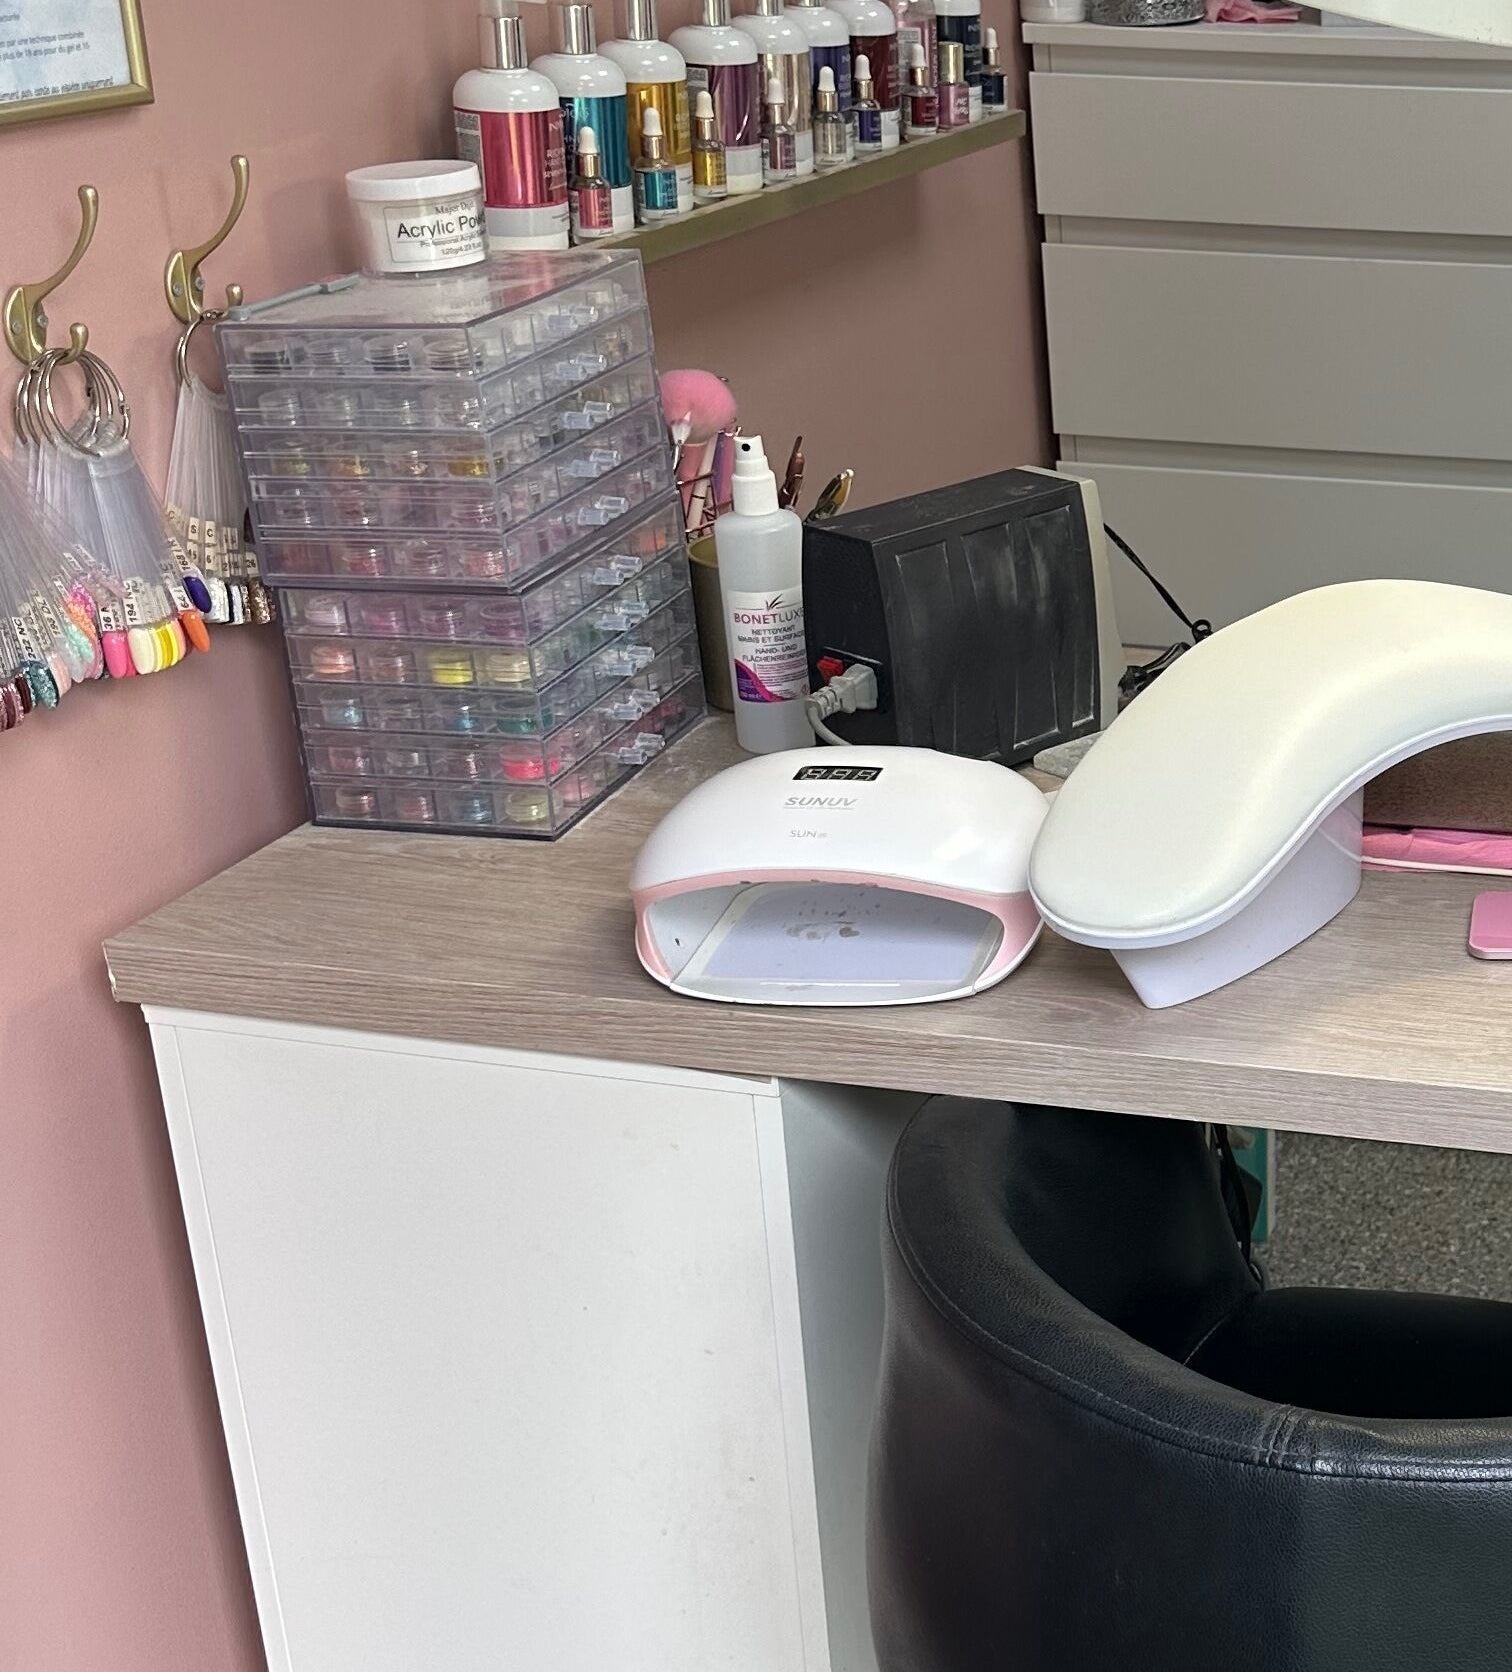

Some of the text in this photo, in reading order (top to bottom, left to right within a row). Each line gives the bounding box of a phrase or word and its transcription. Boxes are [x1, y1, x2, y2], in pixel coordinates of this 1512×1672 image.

[397, 220, 455, 239] Acrylic
[785, 797, 857, 807] SUNUV
[790, 830, 816, 838] SUN
